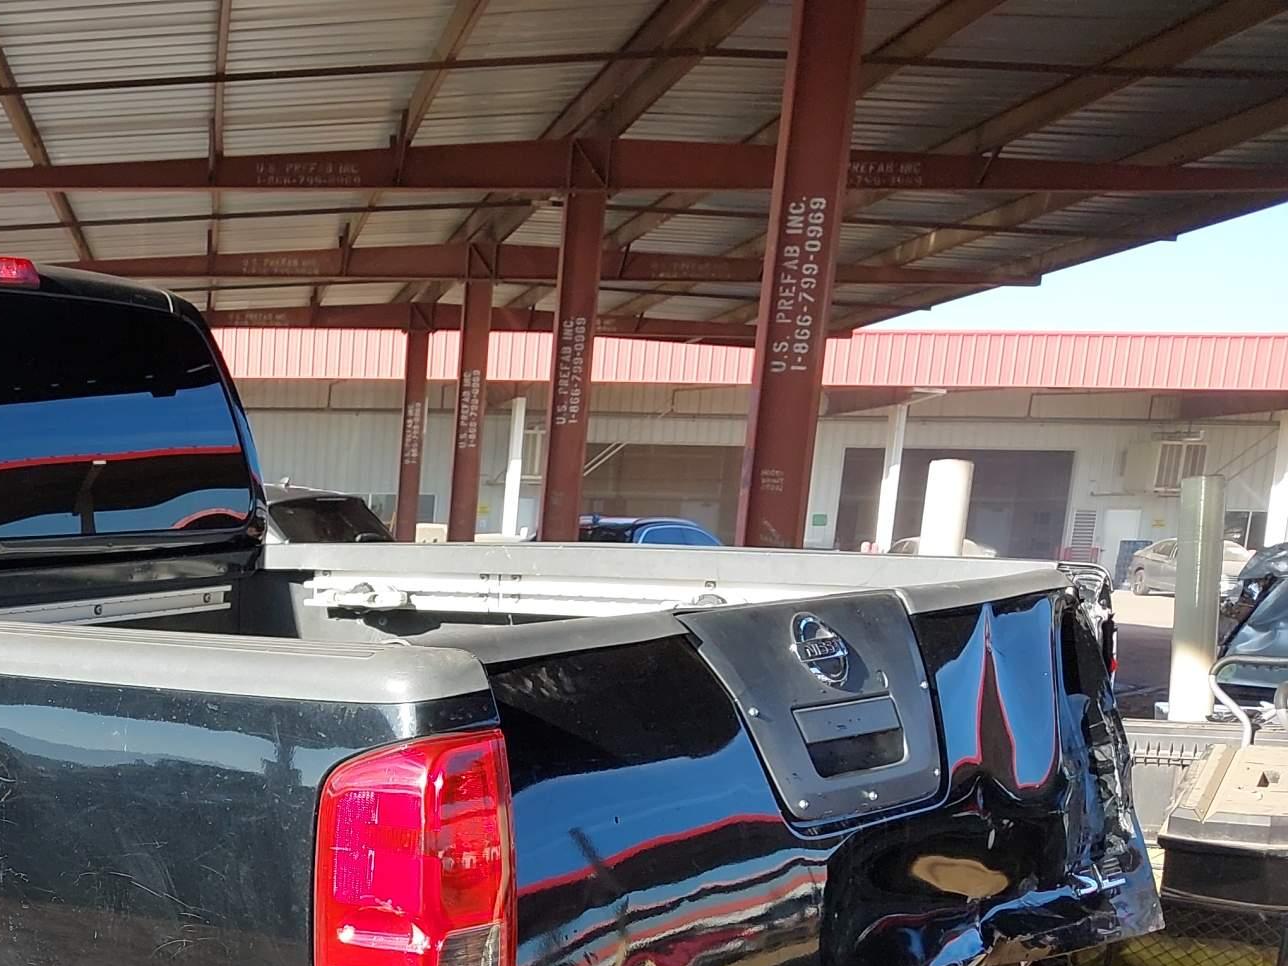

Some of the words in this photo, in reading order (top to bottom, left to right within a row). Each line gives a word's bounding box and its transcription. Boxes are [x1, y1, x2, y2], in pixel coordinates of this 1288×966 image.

[785, 196, 807, 235] INC.
[776, 245, 801, 323] PREFAB
[791, 197, 827, 371] 1-866-799-0969
[558, 346, 572, 395] PREFAB
[568, 317, 587, 424] 1-866-799-0969
[770, 336, 790, 373] U.S.
[555, 400, 568, 425] U.S.
[804, 639, 841, 657] NISS
